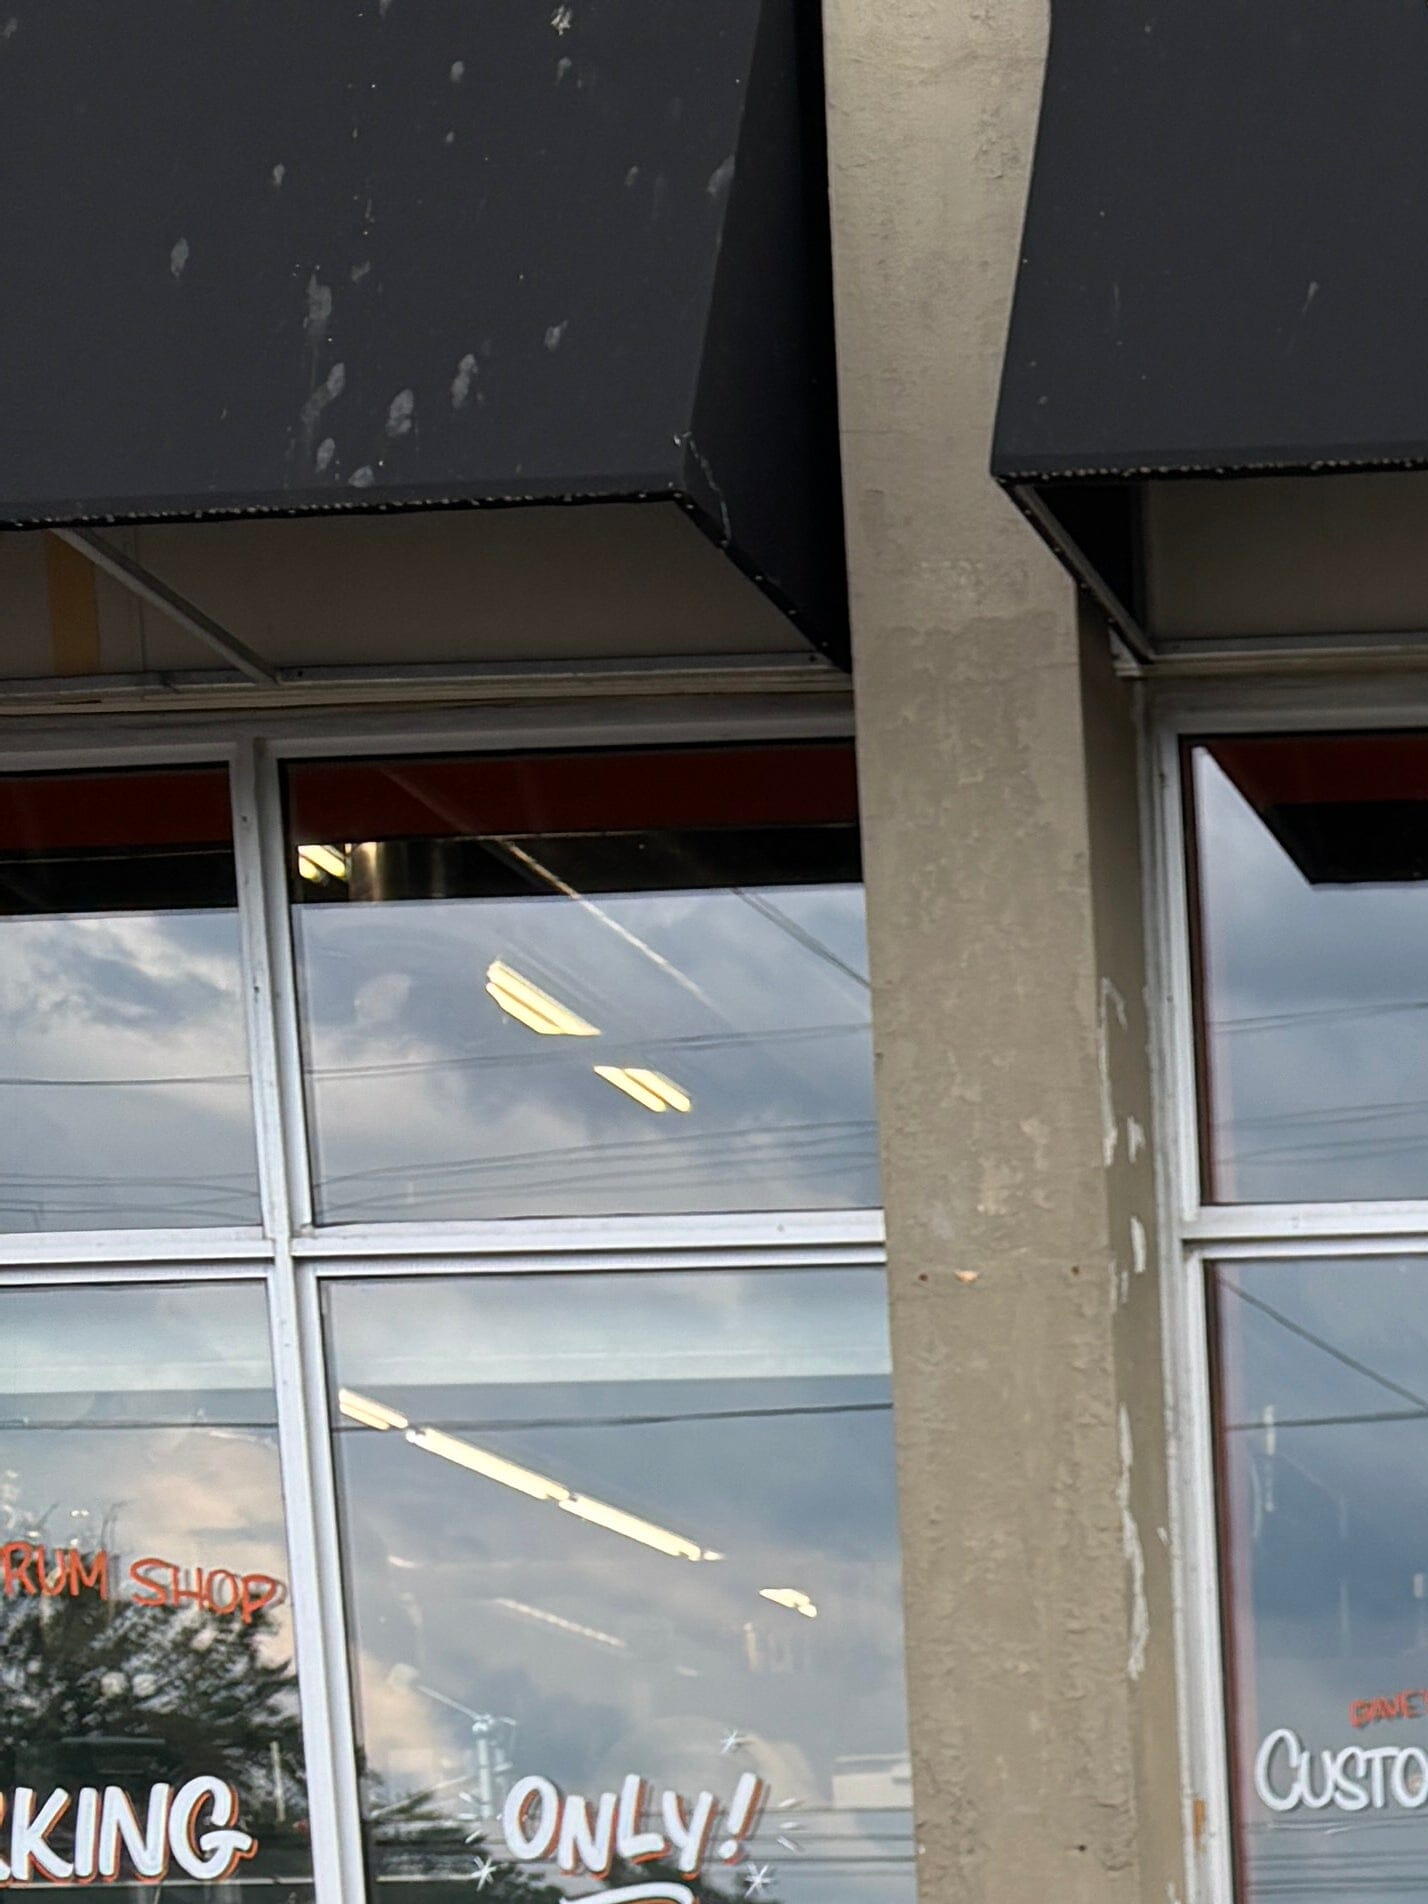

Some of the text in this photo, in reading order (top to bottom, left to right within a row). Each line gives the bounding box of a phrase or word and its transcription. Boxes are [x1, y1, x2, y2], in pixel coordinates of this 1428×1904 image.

[129, 1557, 280, 1626] SHOP
[0, 1775, 258, 1885] KING
[503, 1772, 768, 1881] ONLY!
